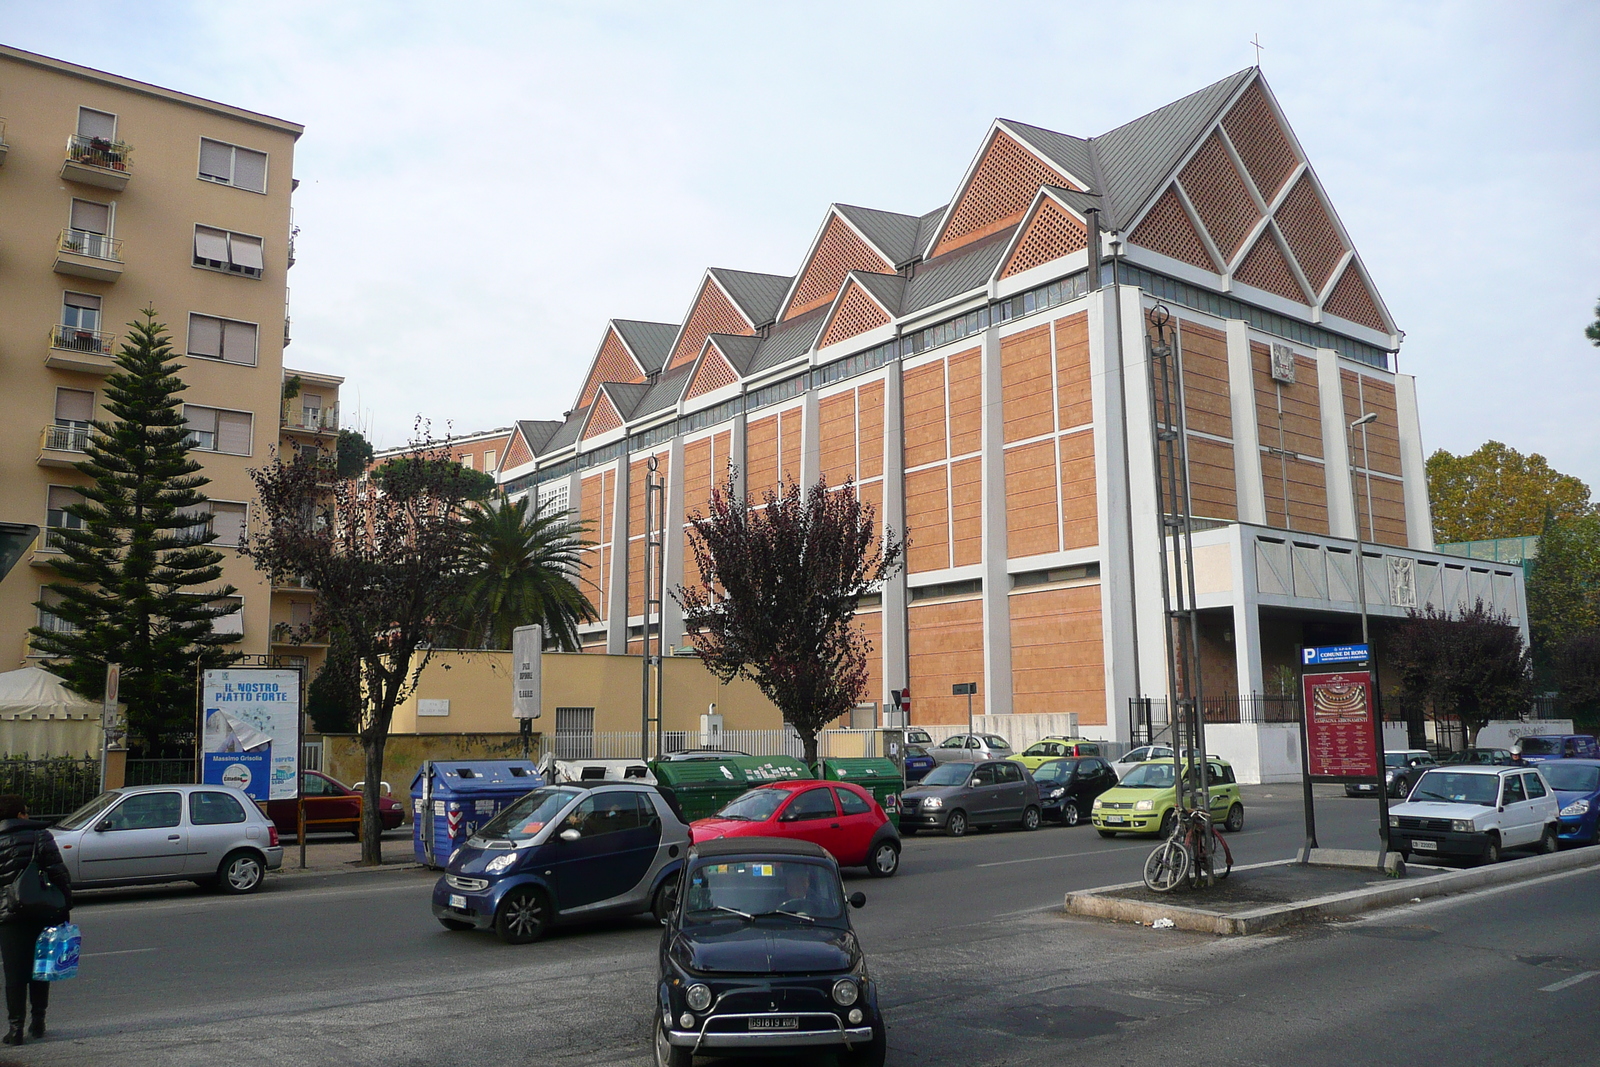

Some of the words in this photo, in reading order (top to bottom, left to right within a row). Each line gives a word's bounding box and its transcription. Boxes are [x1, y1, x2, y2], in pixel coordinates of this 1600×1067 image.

[1303, 648, 1316, 664] P
[225, 683, 233, 692] IL
[238, 682, 279, 692] NOSTRO
[215, 692, 253, 702] PIATTO
[256, 692, 287, 701] FORTE
